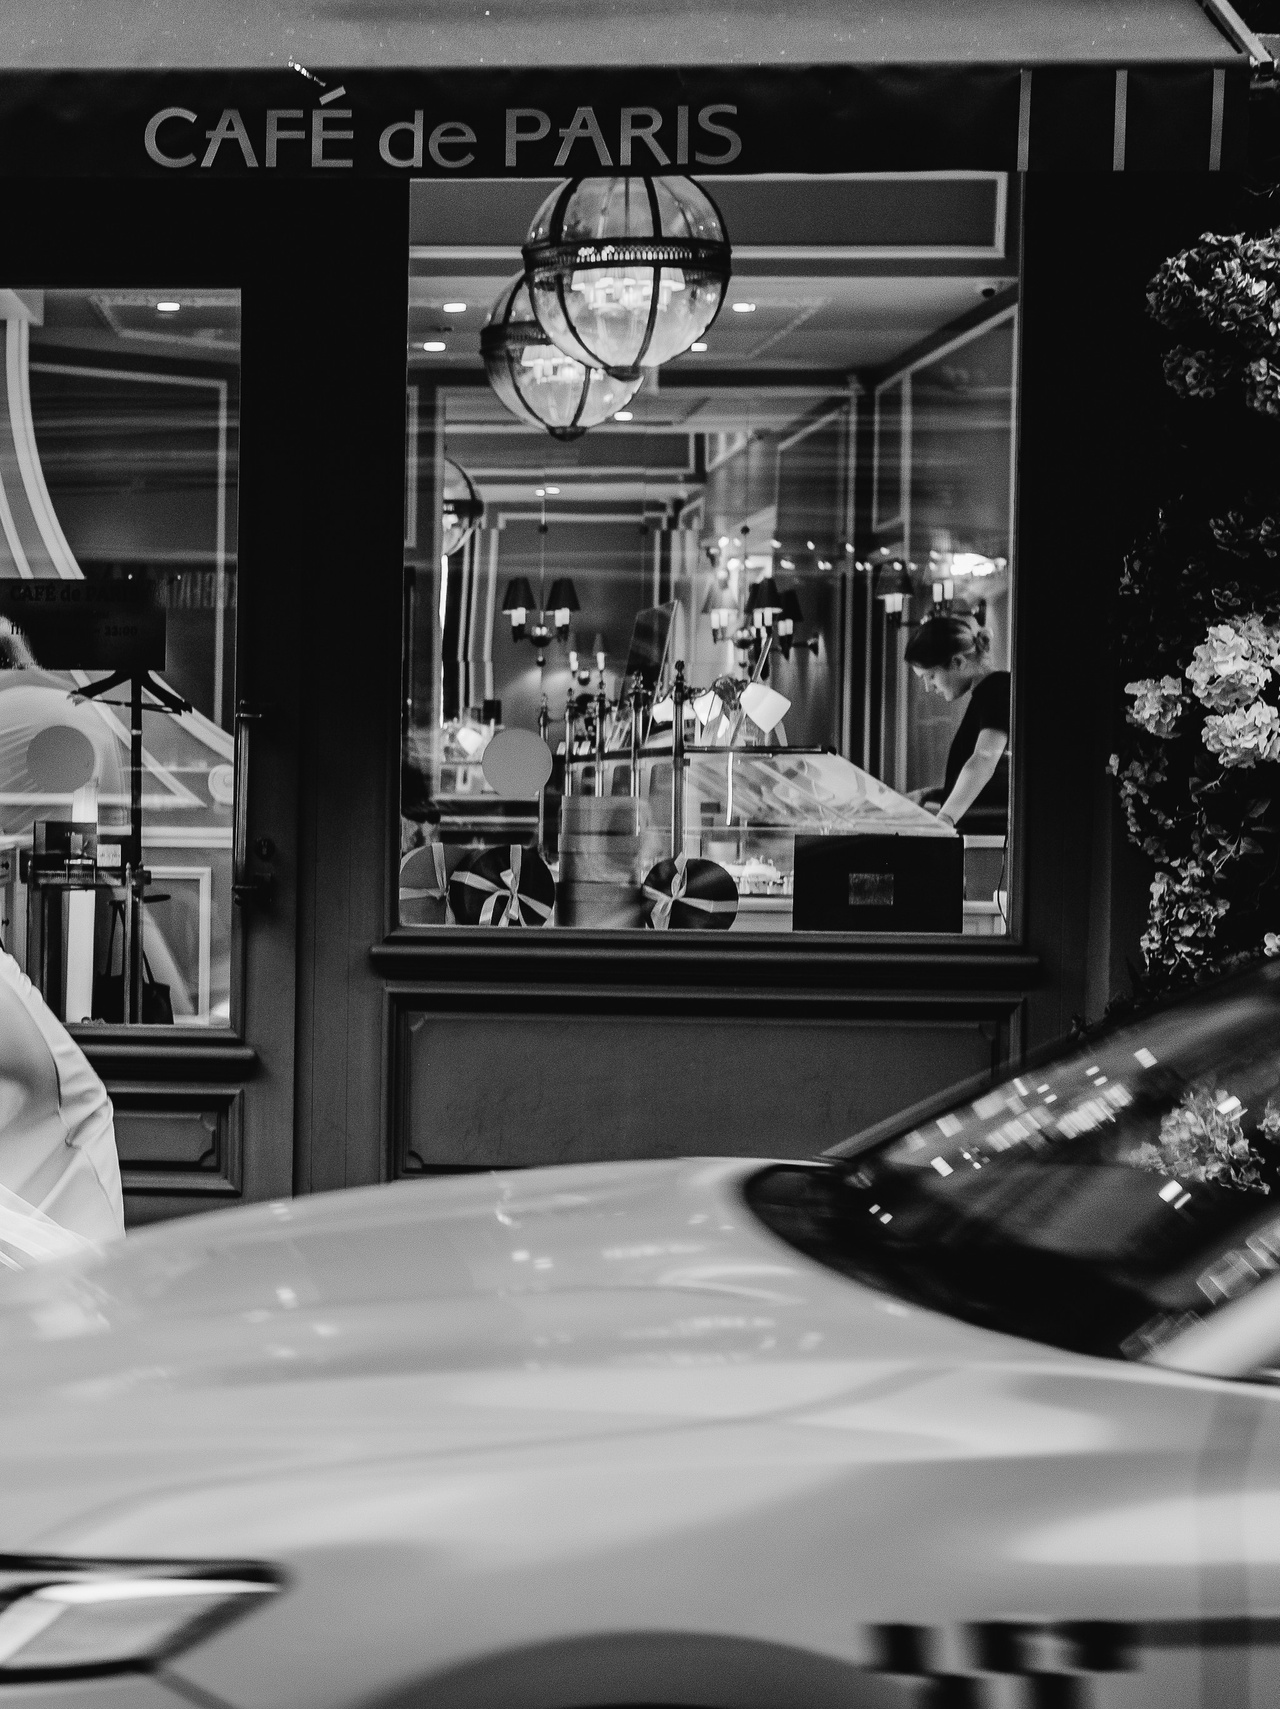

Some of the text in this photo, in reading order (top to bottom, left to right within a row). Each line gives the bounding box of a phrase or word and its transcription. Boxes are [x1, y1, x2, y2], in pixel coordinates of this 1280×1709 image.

[144, 86, 744, 169] CAFÉ de PARIS
[60, 584, 81, 602] de
